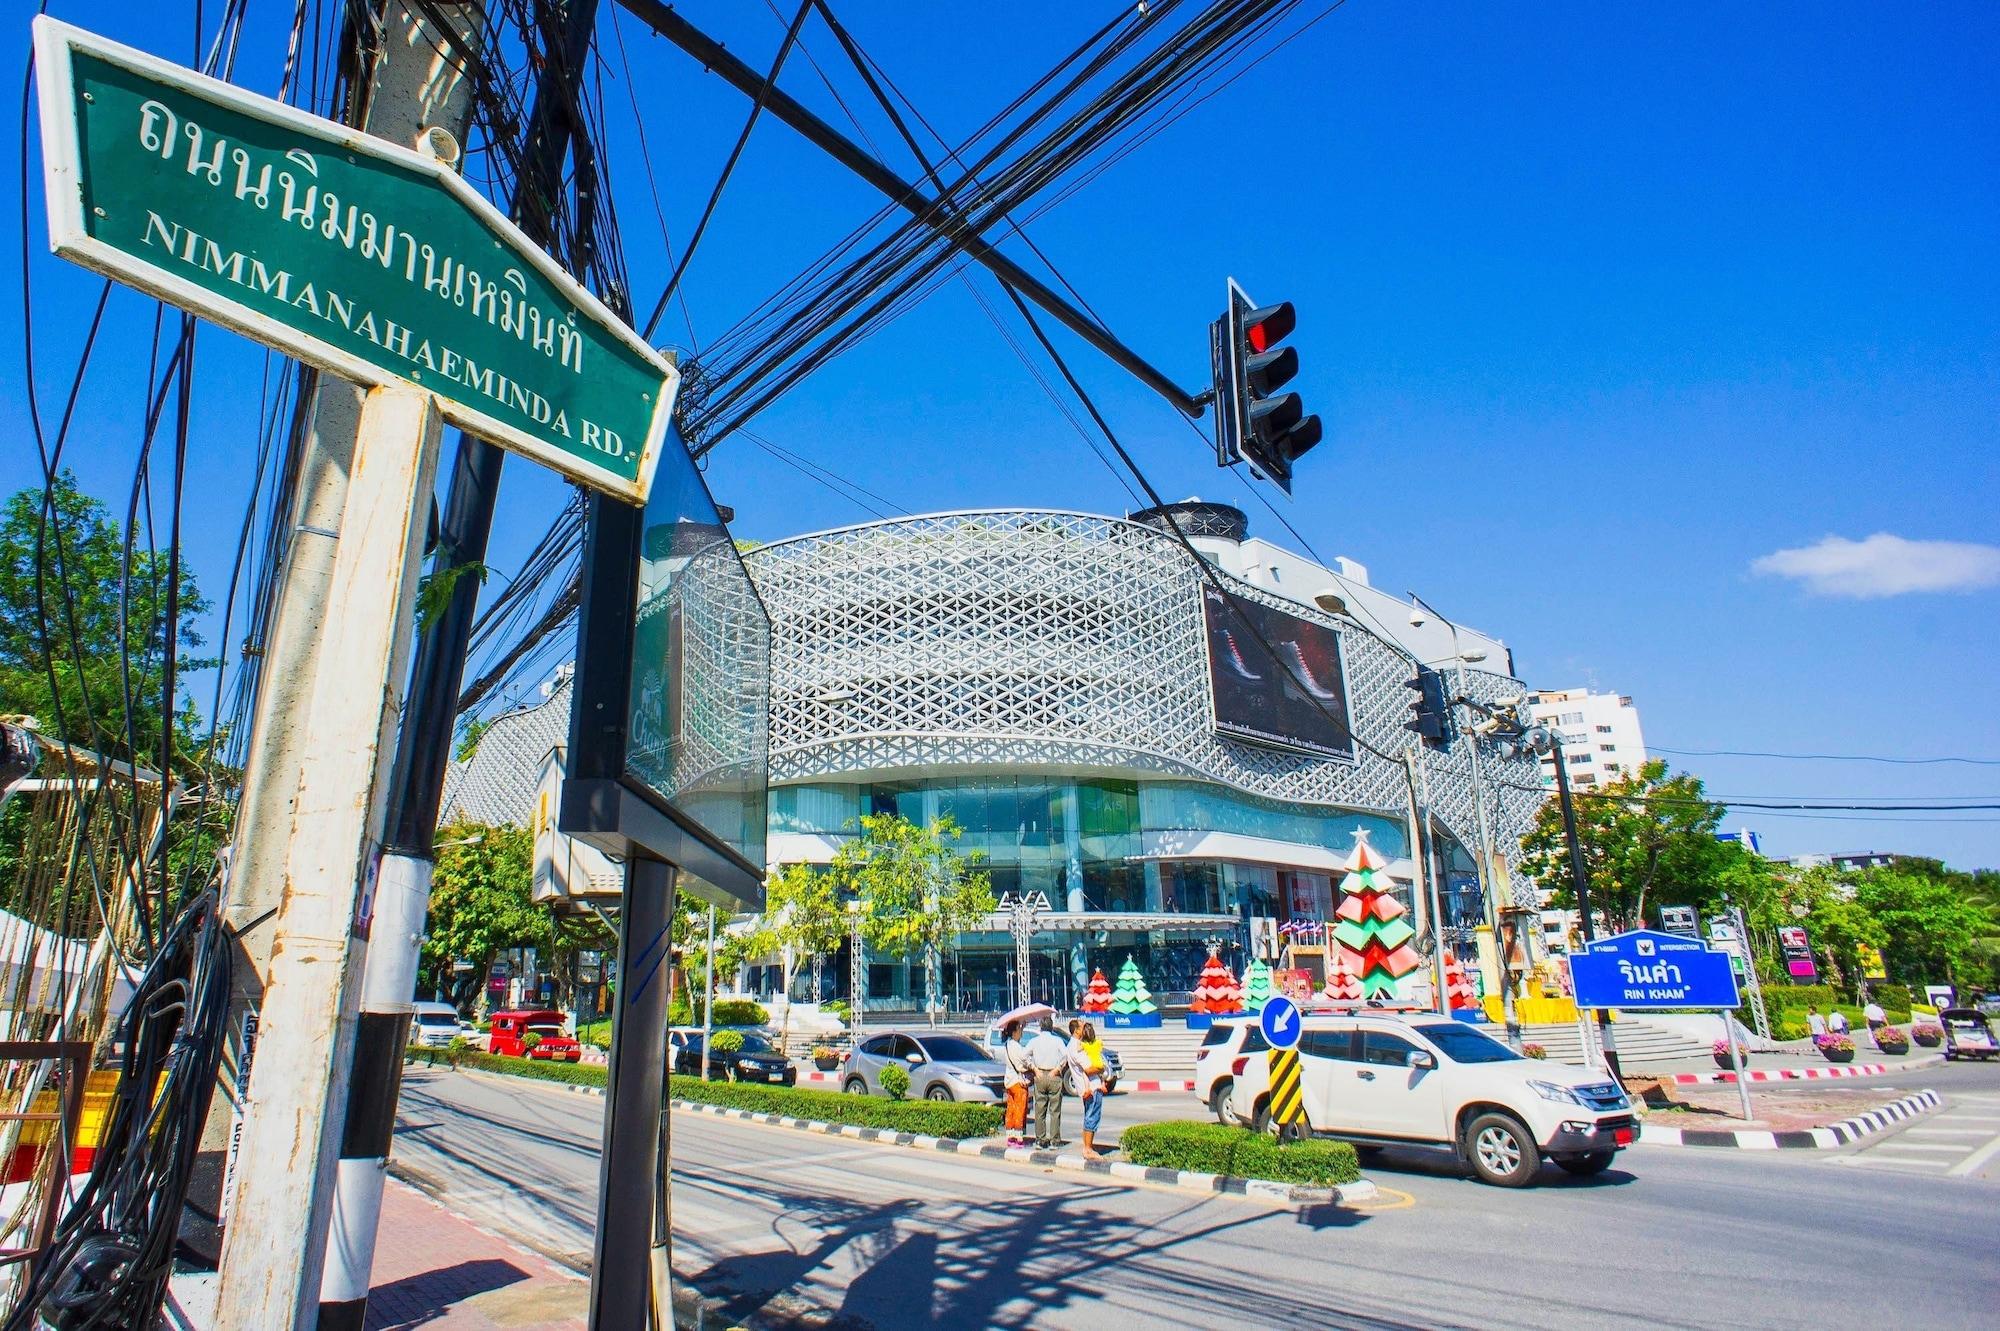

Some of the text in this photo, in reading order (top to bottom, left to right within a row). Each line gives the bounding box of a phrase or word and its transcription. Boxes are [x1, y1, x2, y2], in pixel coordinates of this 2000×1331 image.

[139, 100, 583, 374] ถนนนิมมานเหมินท์
[139, 209, 630, 463] NIMMANAHAEMINDA RD.
[1617, 959, 1683, 984] รินคำ
[1624, 989, 1685, 1000] RIN KHAM
